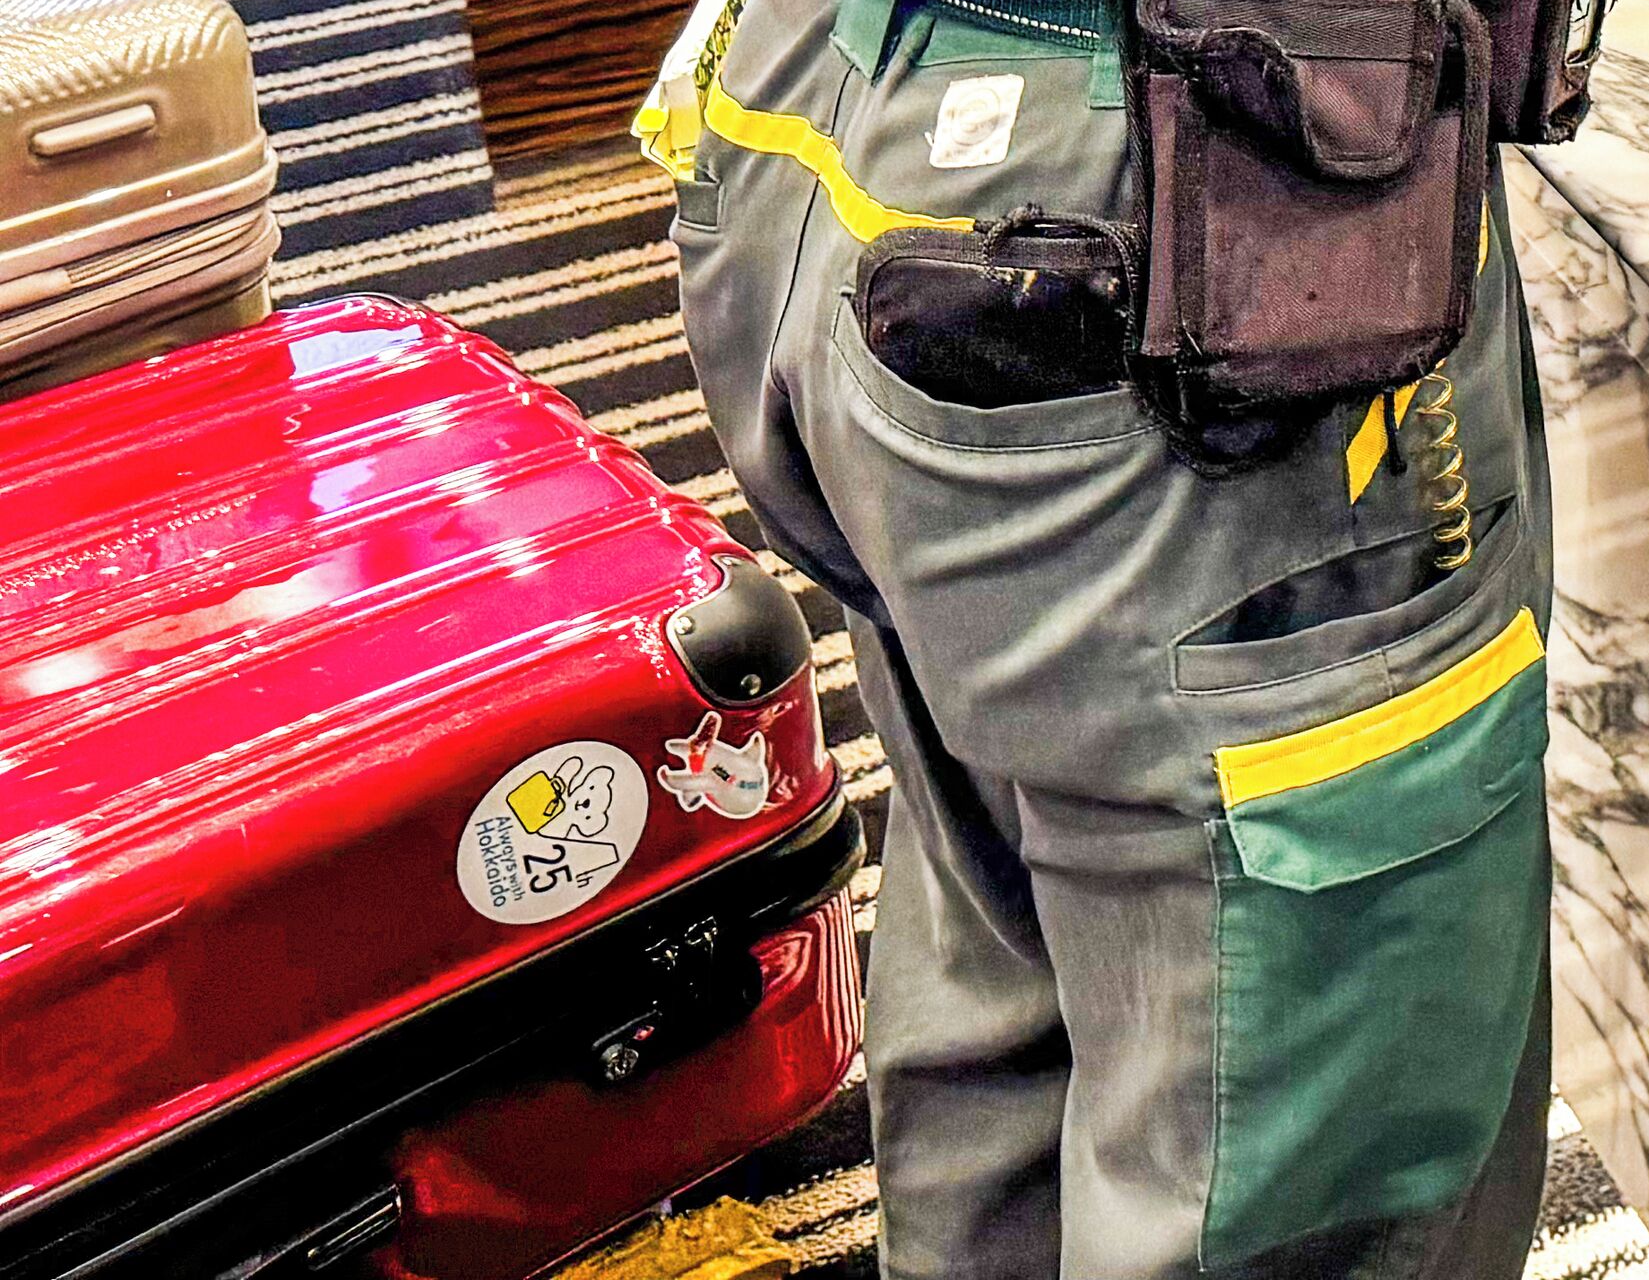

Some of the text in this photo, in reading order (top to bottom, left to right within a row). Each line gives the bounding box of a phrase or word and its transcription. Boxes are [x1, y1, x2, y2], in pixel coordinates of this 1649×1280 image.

[474, 818, 510, 908] Hokkaido
[495, 816, 526, 901] Always with
